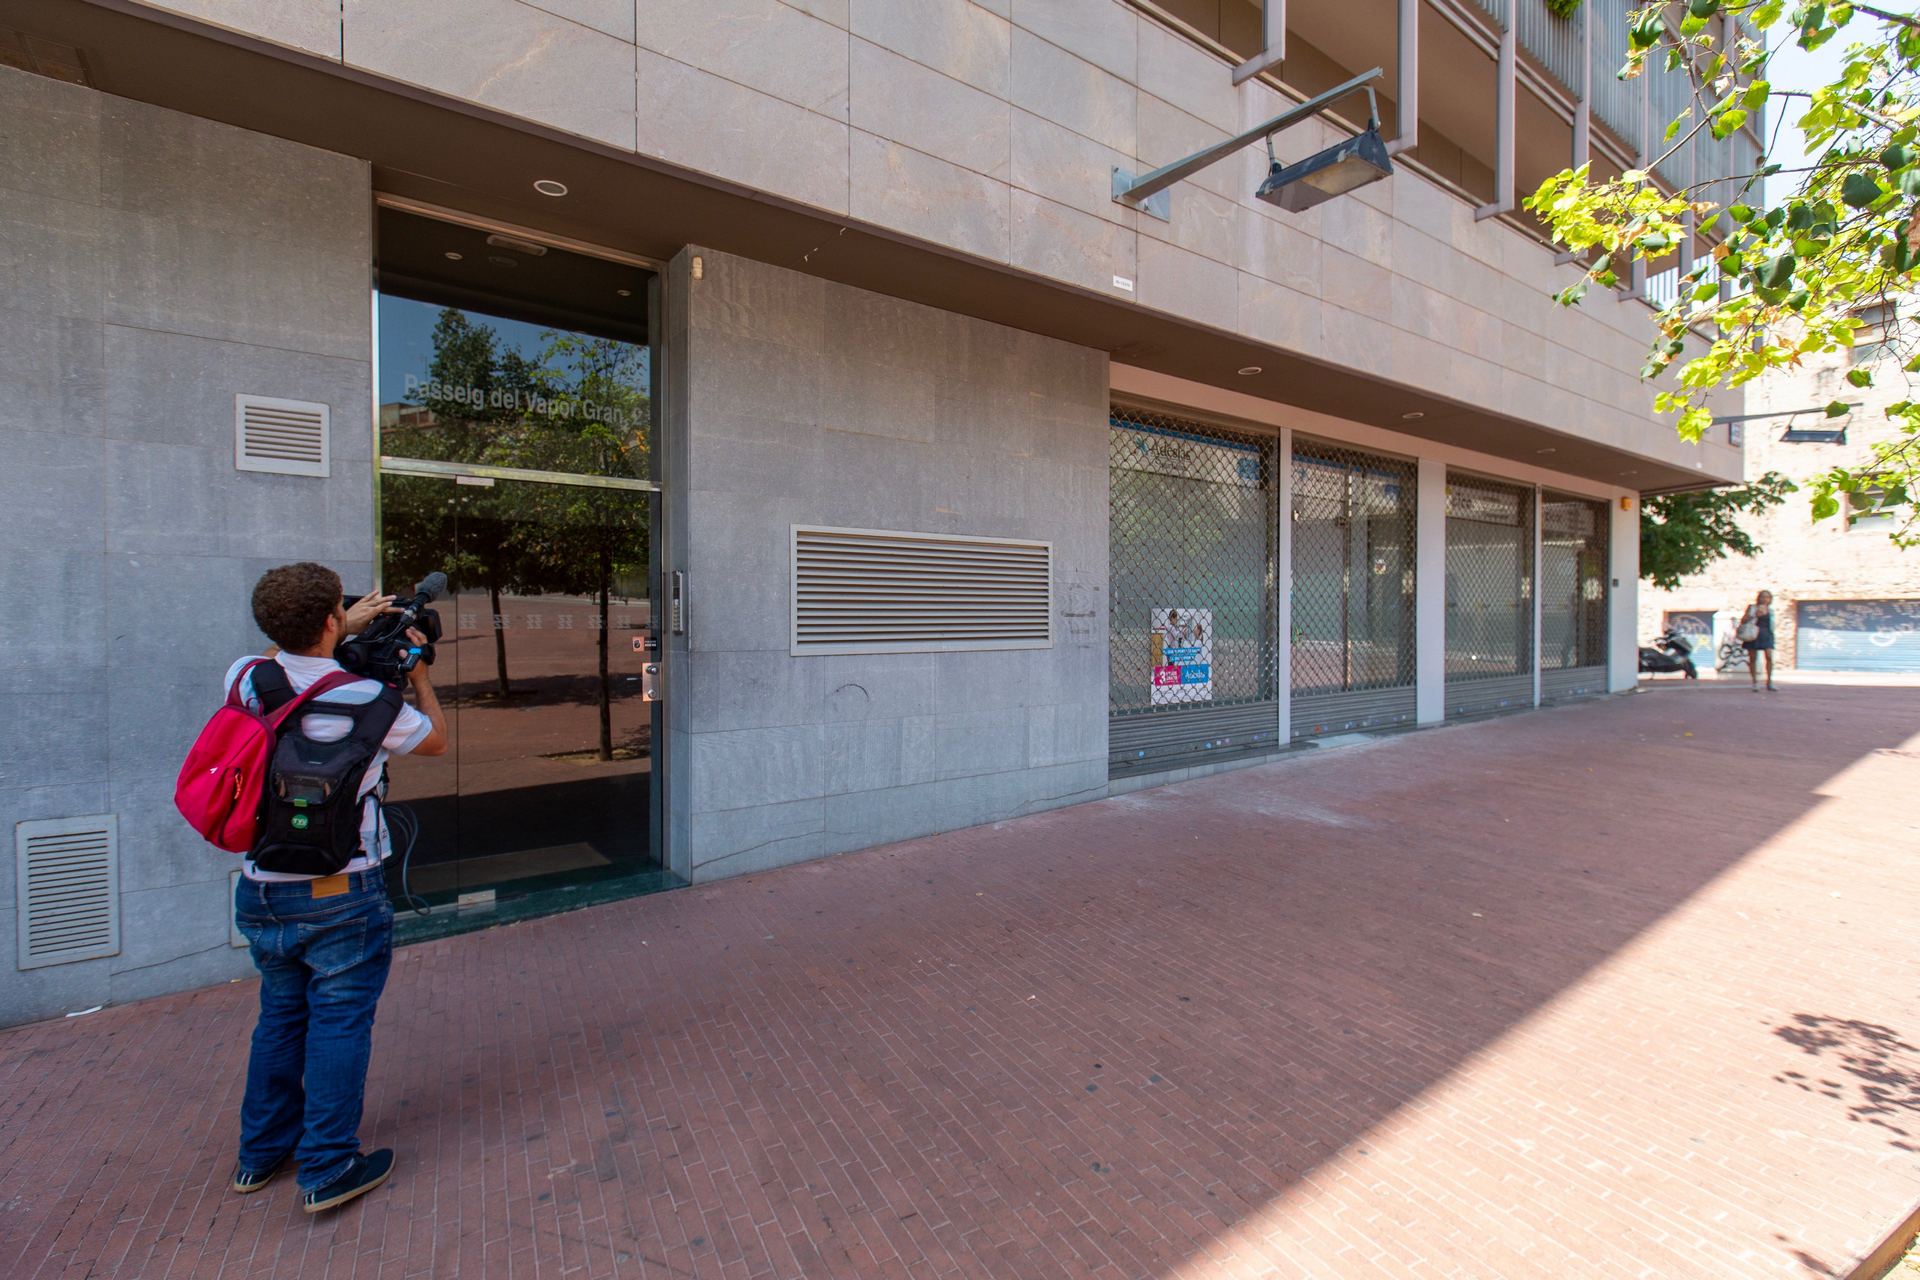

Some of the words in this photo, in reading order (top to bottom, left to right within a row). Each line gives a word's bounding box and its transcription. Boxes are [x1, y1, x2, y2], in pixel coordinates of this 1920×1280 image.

[404, 373, 485, 411] Passeig
[490, 386, 520, 410] del
[525, 390, 577, 420] Vapor
